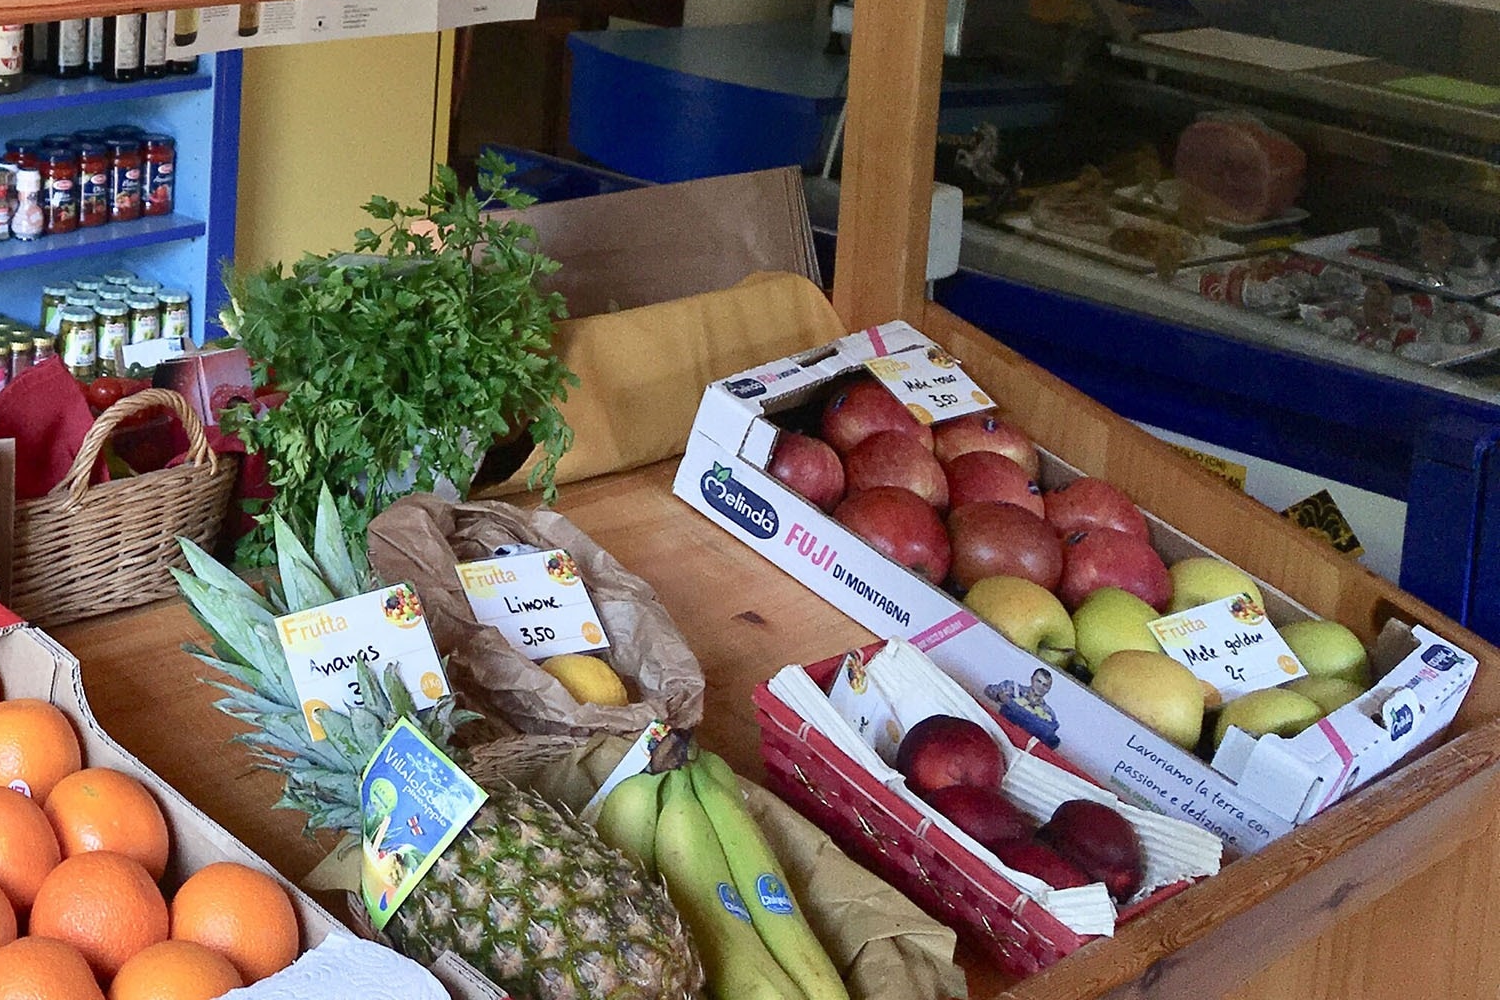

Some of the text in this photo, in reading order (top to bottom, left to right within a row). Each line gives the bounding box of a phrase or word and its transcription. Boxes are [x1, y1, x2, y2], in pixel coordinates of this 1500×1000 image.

[704, 474, 776, 535] Melinda
[461, 568, 517, 590] Frutta
[784, 522, 912, 627] FUJI DI MONTAGNA
[281, 614, 348, 645] Frutta
[520, 627, 555, 647] 3,50
[1154, 617, 1207, 641] Frutta
[310, 645, 380, 676] Ananas
[1182, 645, 1219, 666] Mele
[1114, 760, 1168, 799] passione
[1170, 796, 1179, 806] e
[1126, 734, 1194, 786] Lavoriamo
[1195, 779, 1208, 798] la
[1212, 792, 1245, 821] terra
[1248, 819, 1271, 839] con
